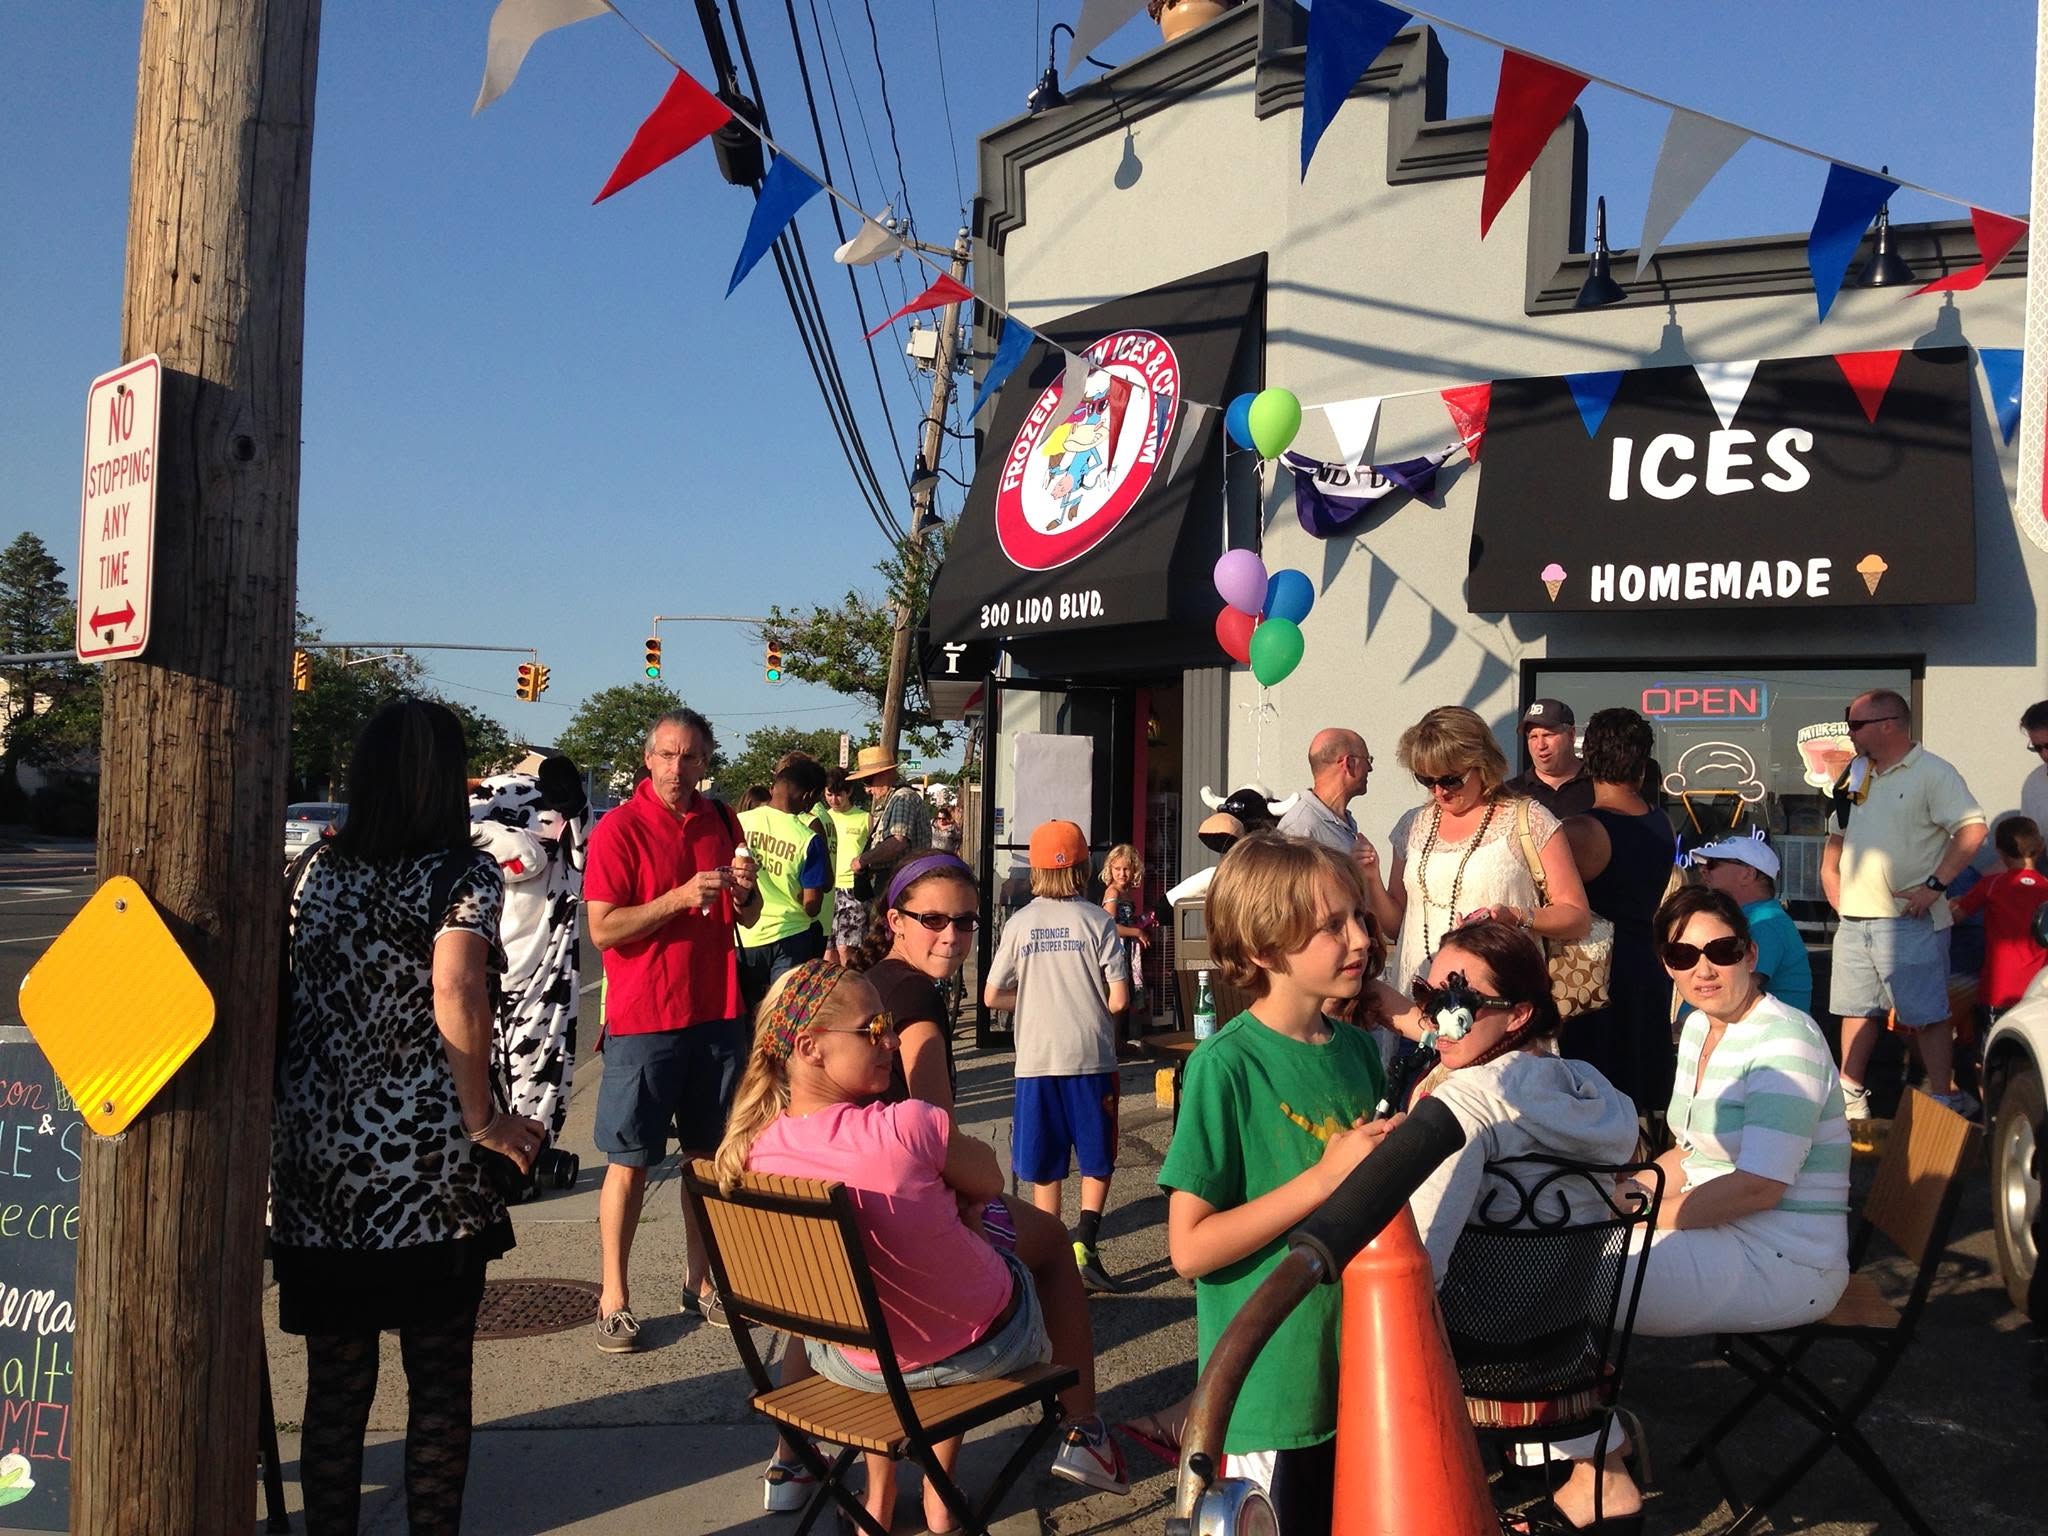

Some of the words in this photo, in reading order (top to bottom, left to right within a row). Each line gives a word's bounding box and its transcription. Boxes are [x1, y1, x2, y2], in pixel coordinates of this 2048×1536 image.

[108, 389, 134, 446] NO
[1002, 389, 1058, 493] FROZEN
[1111, 335, 1157, 365] ICES
[1145, 351, 1166, 378] &
[88, 447, 150, 499] STOPPING
[1608, 427, 1814, 501] ICES
[102, 502, 130, 542] ANY
[99, 551, 129, 590] TIME
[1591, 557, 1832, 603] HOMEMADE
[980, 602, 1010, 629] 300
[1015, 596, 1053, 624] LIDO
[1059, 589, 1105, 620] BLVD.
[1642, 688, 1757, 715] OPEN
[1030, 927, 1070, 940] STRONGER
[1034, 941, 1040, 953] A
[1040, 940, 1062, 952] SUPER
[1063, 940, 1086, 952] STORM
[38, 1113, 56, 1136] &
